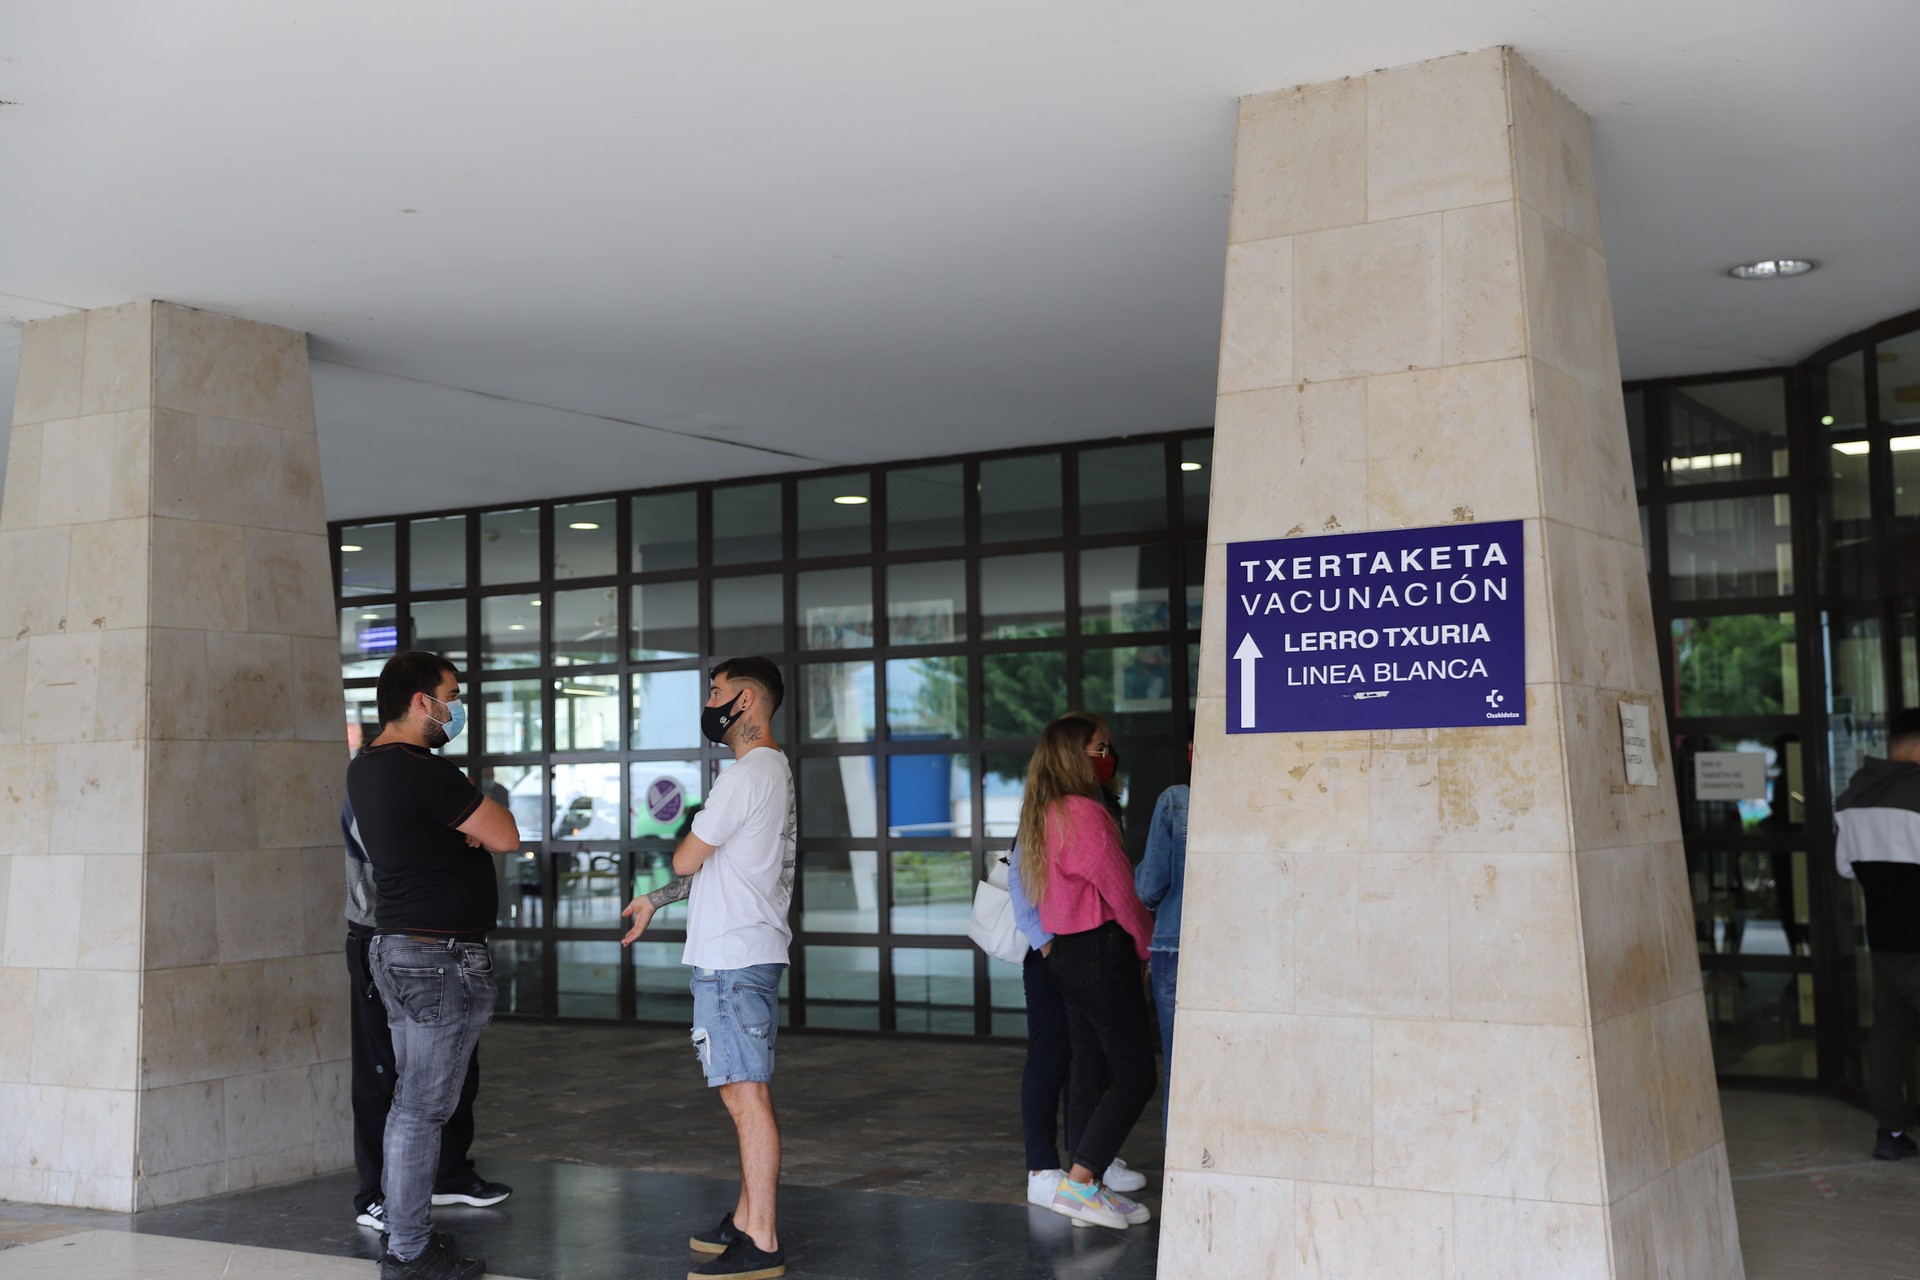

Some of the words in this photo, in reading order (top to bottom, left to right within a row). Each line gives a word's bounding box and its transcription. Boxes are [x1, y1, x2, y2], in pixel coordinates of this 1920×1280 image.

[1240, 542, 1508, 583] TXERTAKETA
[1240, 574, 1507, 616] VACUNACIÓN
[1284, 628, 1379, 652] LERRO
[1383, 623, 1491, 647] TXURIA
[1287, 664, 1366, 686] LINEA
[1374, 658, 1489, 683] BLANCA
